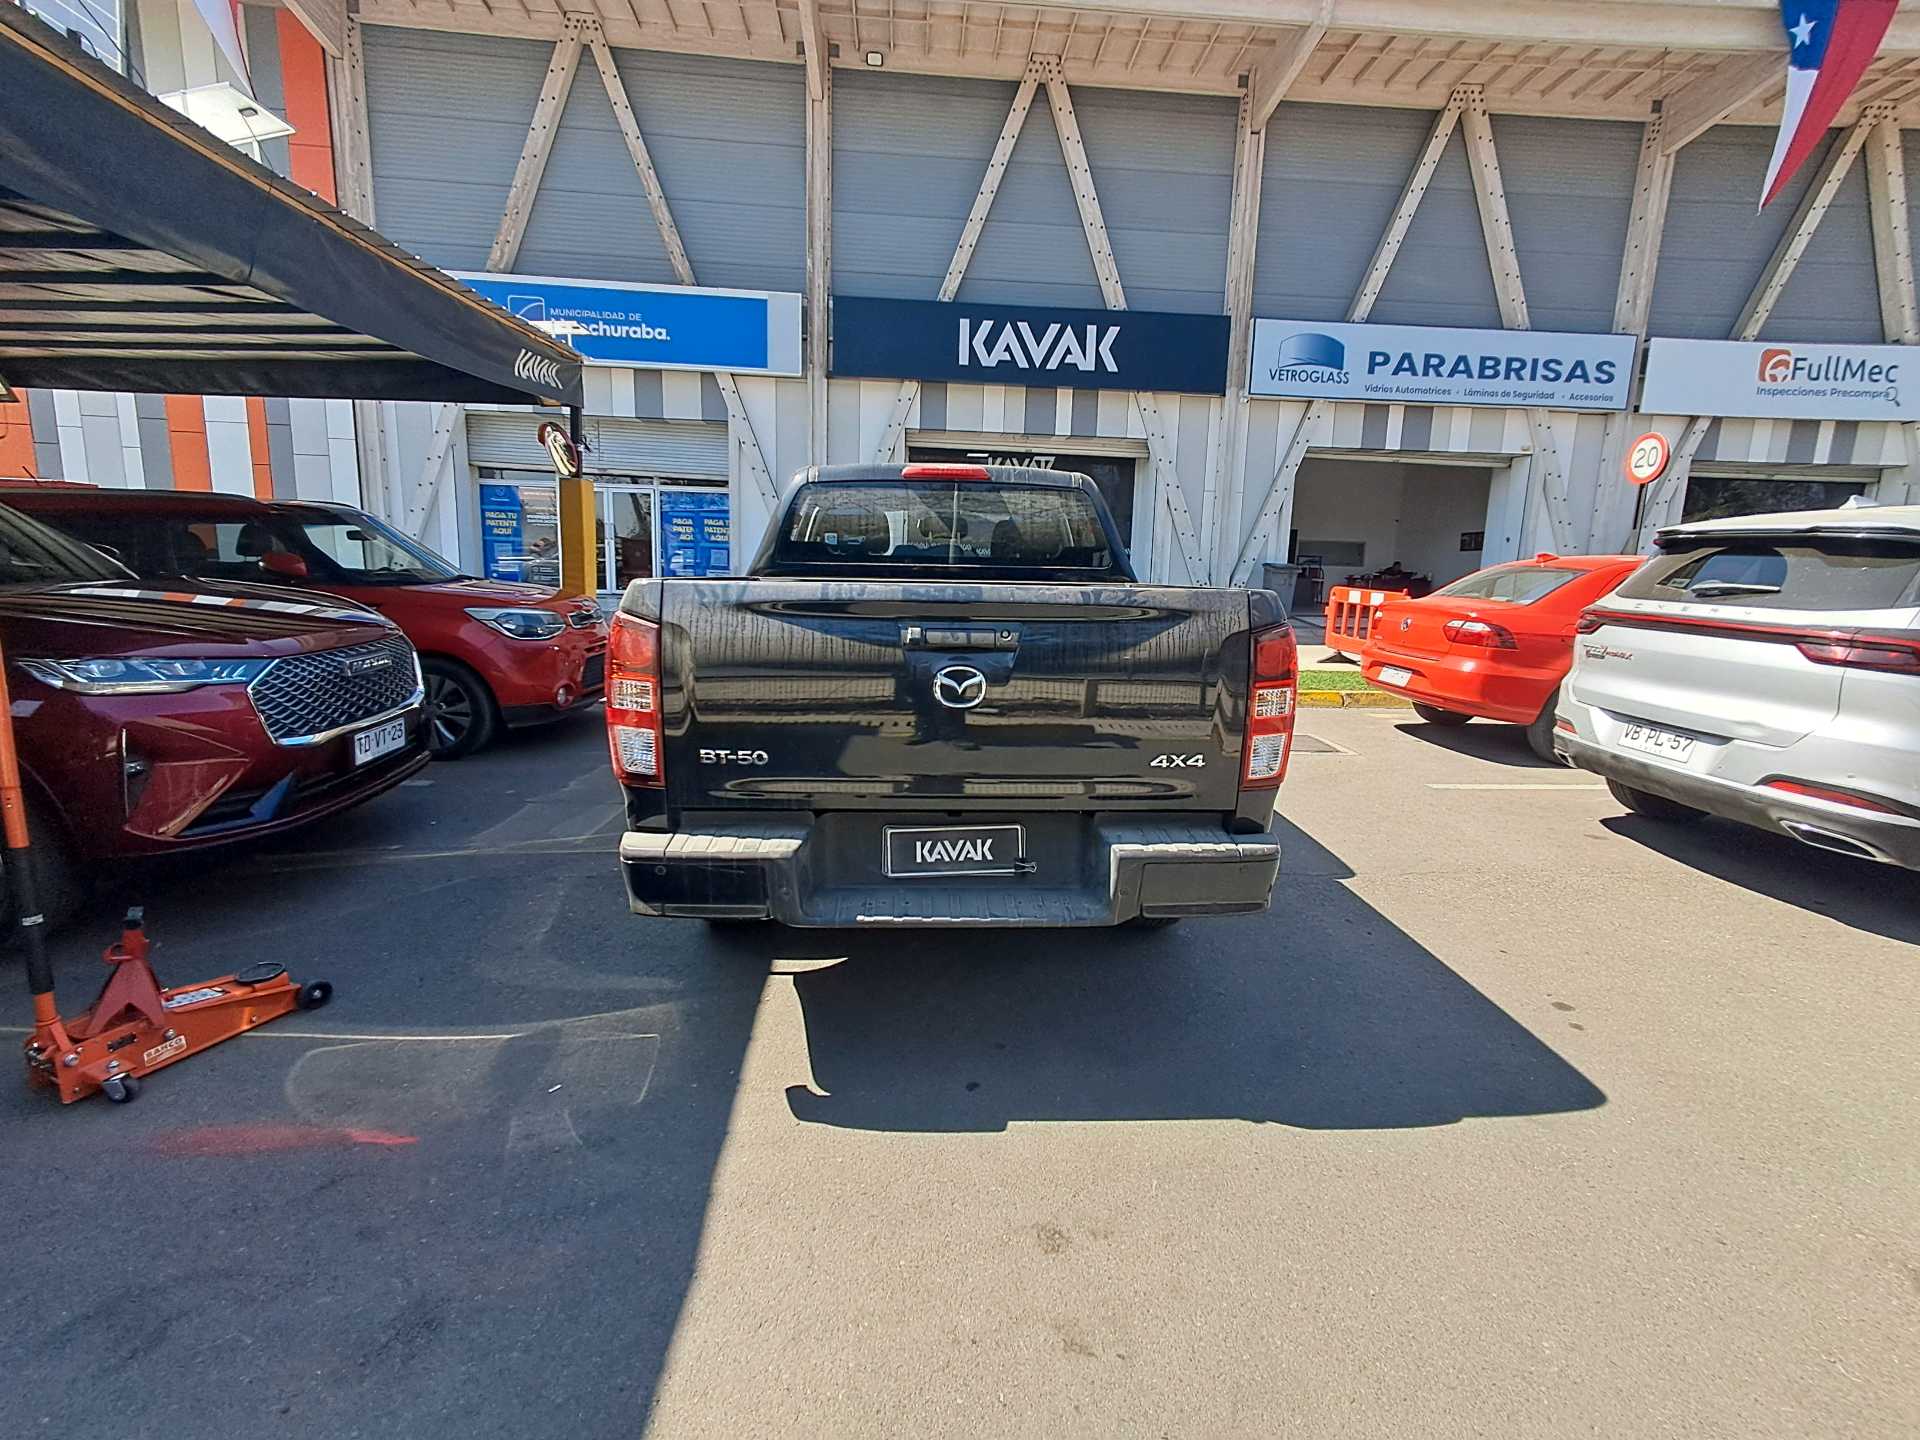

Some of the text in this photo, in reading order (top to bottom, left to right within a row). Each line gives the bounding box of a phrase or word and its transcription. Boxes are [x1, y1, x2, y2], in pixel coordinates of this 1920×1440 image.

[550, 307, 643, 321] MUNICIPALIDAD DE
[958, 318, 1121, 373] KAVAK
[514, 348, 563, 389] KAVAK
[1268, 368, 1350, 385] VETROGLASS
[1367, 350, 1616, 385] PARABRISAS
[1791, 355, 1899, 383] FullMec
[1364, 384, 1614, 403] Vidrios Automotrices Láminas de Seguridad Accesorios
[1756, 386, 1889, 399] Inspecciones Precompra
[1634, 446, 1658, 468] 20
[485, 511, 508, 519] PAGA
[486, 519, 517, 527] PATENTE
[672, 518, 694, 526] PAGA
[700, 749, 768, 765] BT-50
[916, 839, 993, 863] KAVAK
